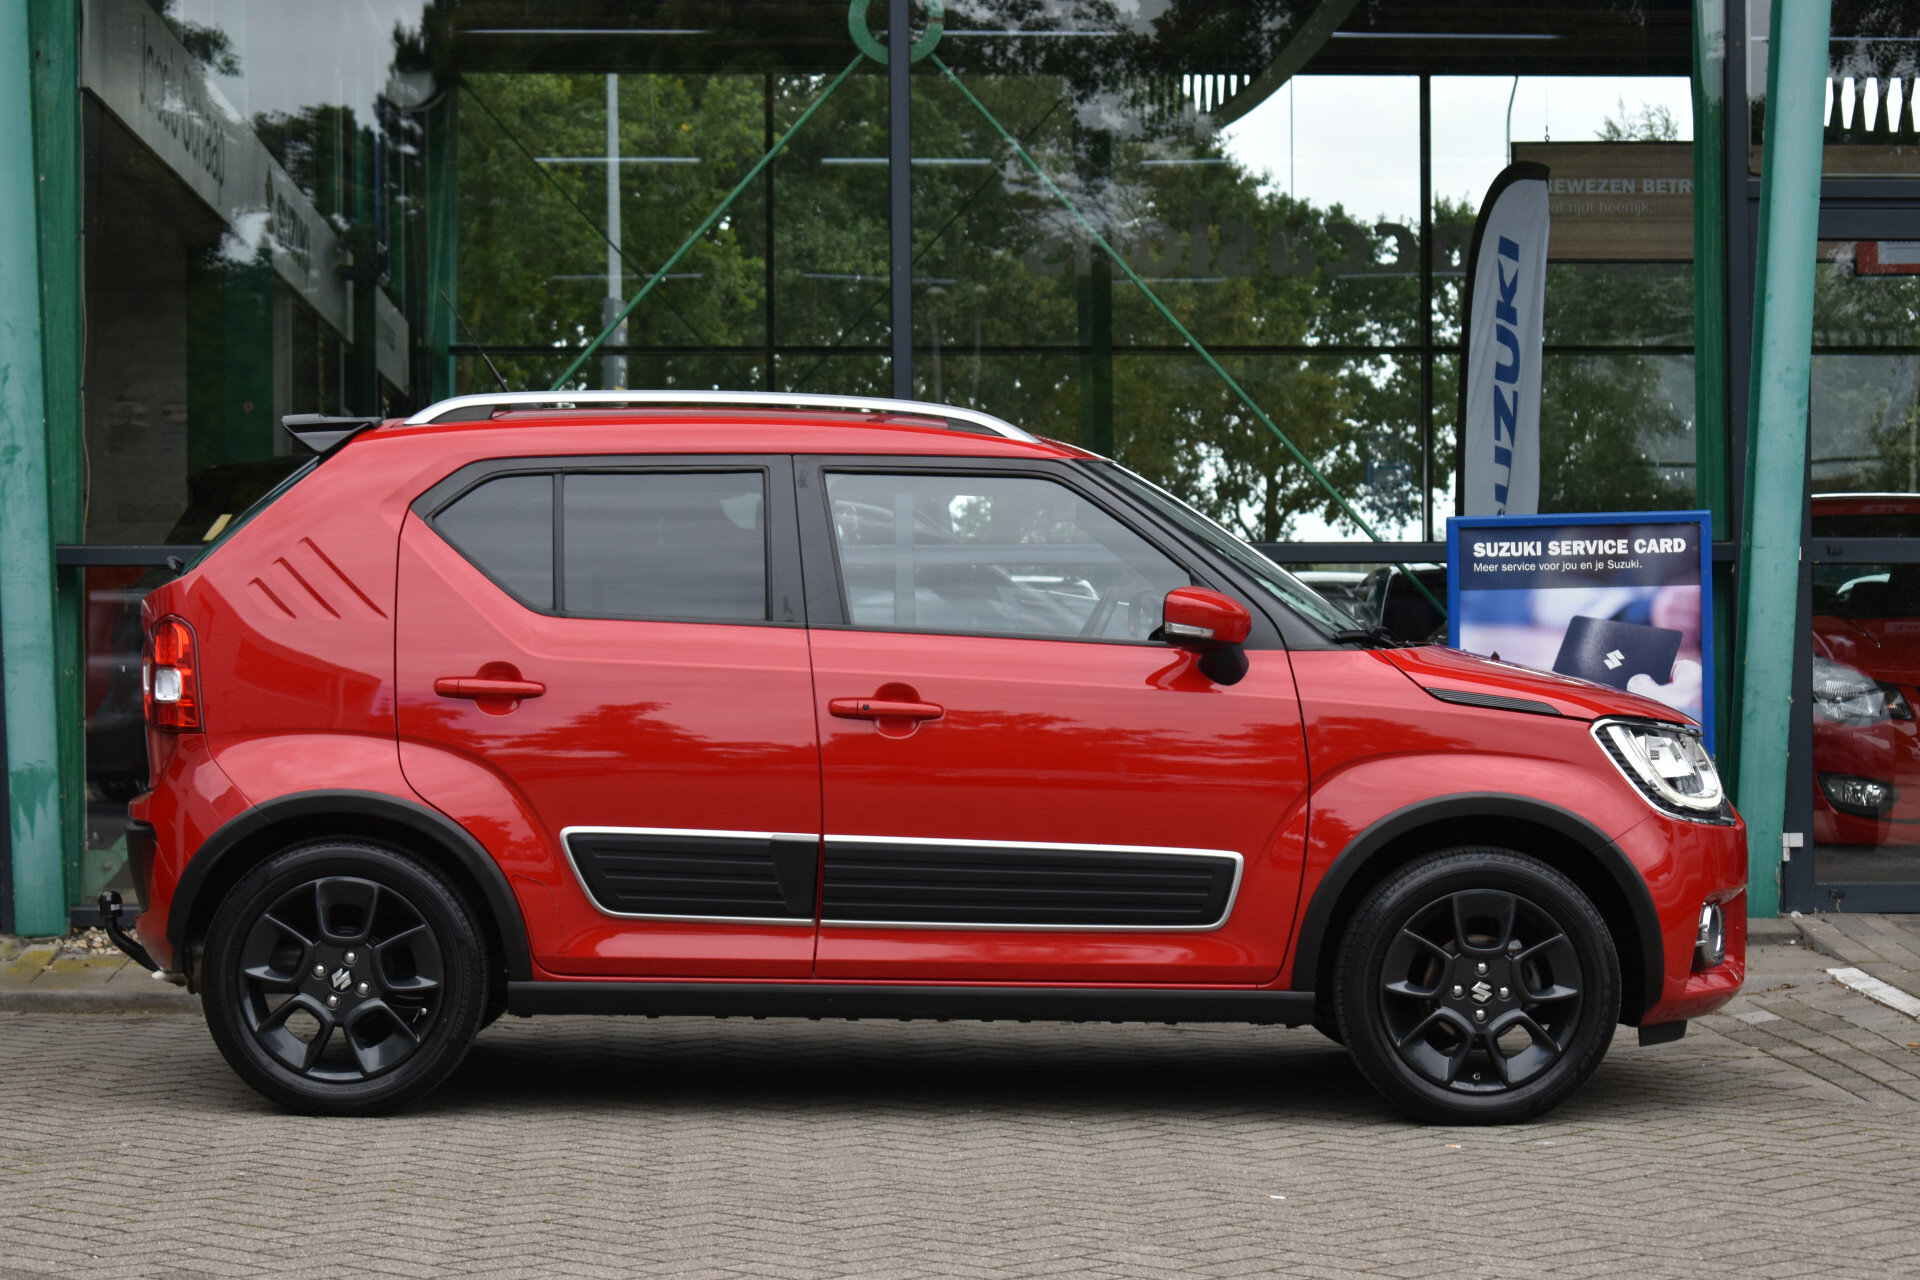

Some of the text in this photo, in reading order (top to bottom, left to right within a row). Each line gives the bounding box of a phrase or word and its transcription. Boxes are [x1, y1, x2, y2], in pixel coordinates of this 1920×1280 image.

[1642, 178, 1694, 194] BETR
[1569, 201, 1594, 216] rijdt
[1600, 201, 1653, 216] heerlijk.
[1494, 235, 1520, 516] UZUKI
[1473, 538, 1686, 557] SUZUKI SERVICE CARD
[1473, 559, 1643, 572] Meer service voor jou en je Suzuki.
